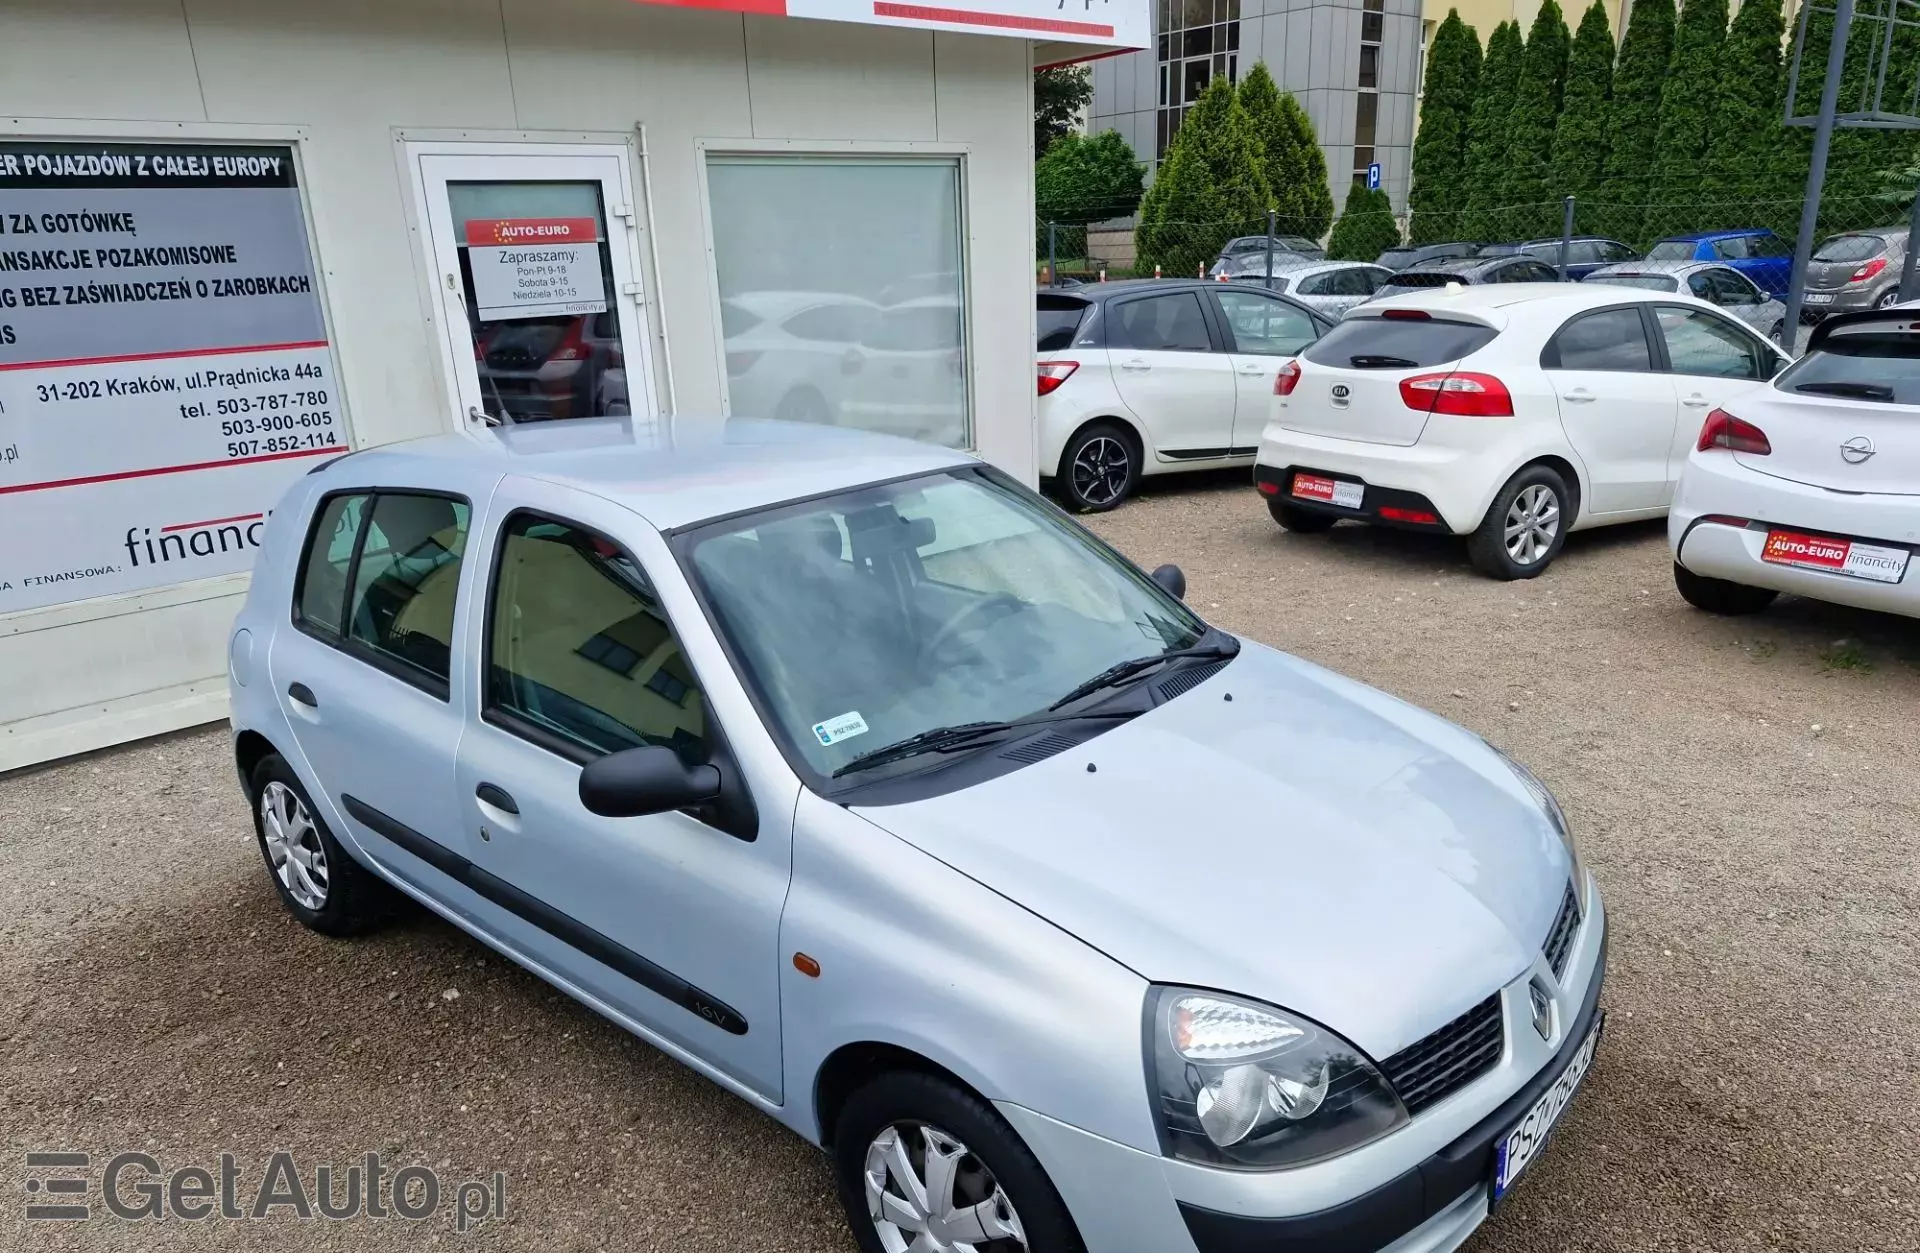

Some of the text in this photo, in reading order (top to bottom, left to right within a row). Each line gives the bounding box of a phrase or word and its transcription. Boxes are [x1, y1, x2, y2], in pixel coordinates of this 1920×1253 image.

[23, 150, 133, 176] POJAZDÓW
[134, 155, 149, 176] Z
[152, 155, 209, 177] CAŁEJ
[213, 156, 281, 177] EUROPY
[1371, 166, 1379, 188] P
[9, 214, 39, 234] ZA
[41, 208, 137, 237] GOTÓWKĘ
[501, 225, 570, 238] AUTO-EURO
[96, 245, 237, 269] POZAKOMISOWE
[499, 250, 580, 266] Zapraszamy:
[517, 265, 567, 277] Pon-Pt 9-18
[20, 286, 61, 307] BEZ
[62, 276, 193, 305] ZAŚWIADCZEŃ
[196, 279, 208, 299] O
[211, 275, 311, 298] ZAROBKACH
[513, 287, 577, 300] Niedziela 10-15
[518, 277, 569, 288] Sobota 9-15
[36, 363, 323, 403] 31-202 Kraków, ul.Prądnicka 44a
[1333, 387, 1347, 396] KIA
[180, 390, 329, 419] tel. 503-787-780
[222, 411, 333, 437] 503-900-605
[227, 431, 337, 458] 507-852-114
[1297, 481, 1333, 494] AUTO-EURO
[1773, 540, 1844, 560] AUTO-EURO
[1848, 551, 1906, 573] financity
[23, 565, 122, 587] FINANSOWA:
[696, 1001, 726, 1025] 16V
[1506, 1096, 1549, 1180] PSZ
